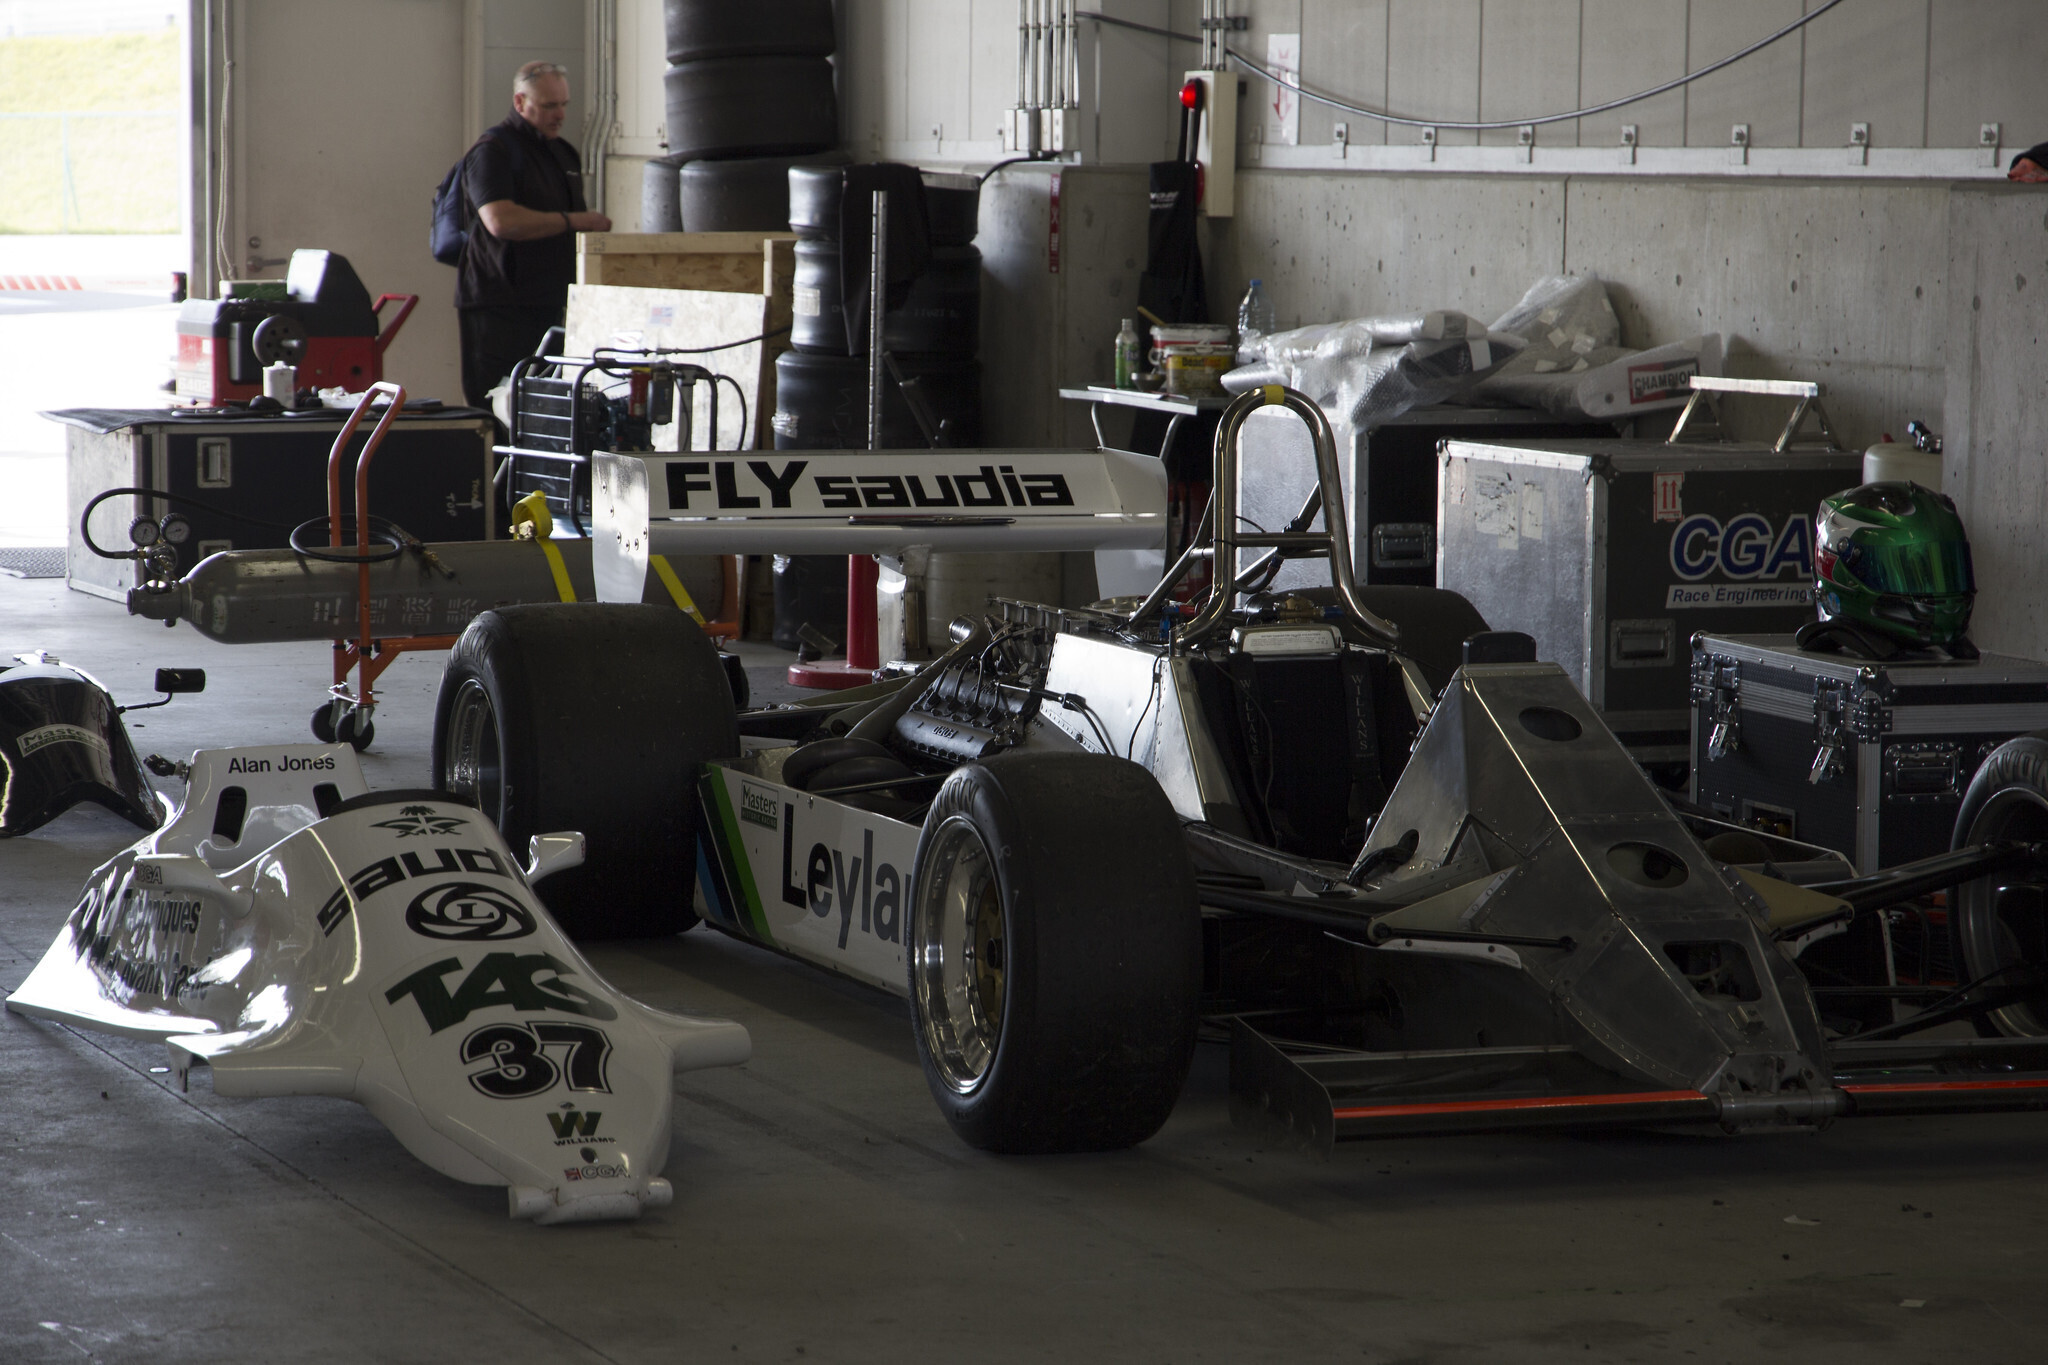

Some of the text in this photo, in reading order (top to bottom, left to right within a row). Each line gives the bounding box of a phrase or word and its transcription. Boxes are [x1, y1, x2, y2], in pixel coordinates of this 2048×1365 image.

[666, 461, 1075, 509] FLY saudia
[1670, 513, 1814, 580] CGA
[1673, 587, 1810, 605] Race Engineering
[1240, 679, 1259, 755] WLLANS
[1351, 674, 1369, 750] WILLANS
[228, 755, 335, 774] Alan Jones
[743, 785, 777, 816] Masters
[459, 1021, 613, 1100] 37
[554, 1137, 616, 1147] WILLIAMS
[581, 1165, 631, 1179] CGA
